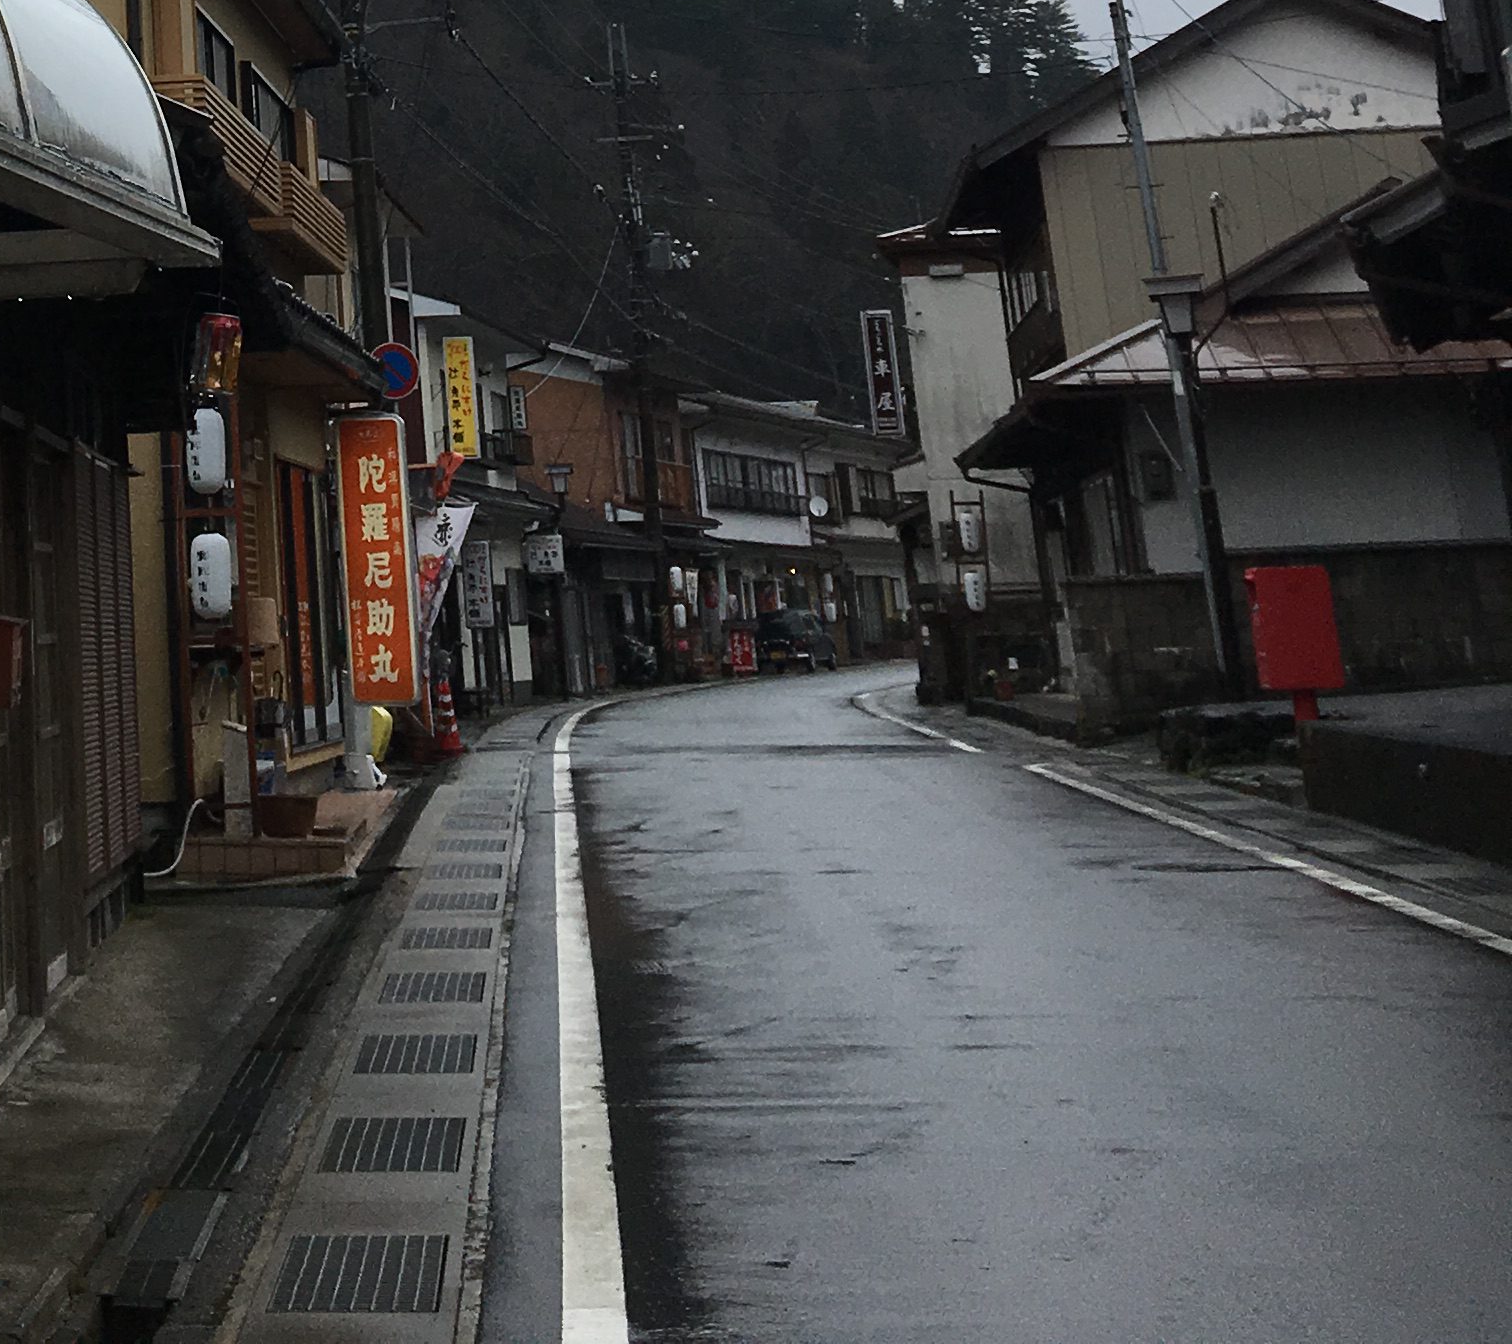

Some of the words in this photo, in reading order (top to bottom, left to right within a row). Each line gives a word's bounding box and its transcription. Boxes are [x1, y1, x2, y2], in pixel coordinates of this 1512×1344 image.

[357, 453, 400, 683] 陀羅尼助丸
